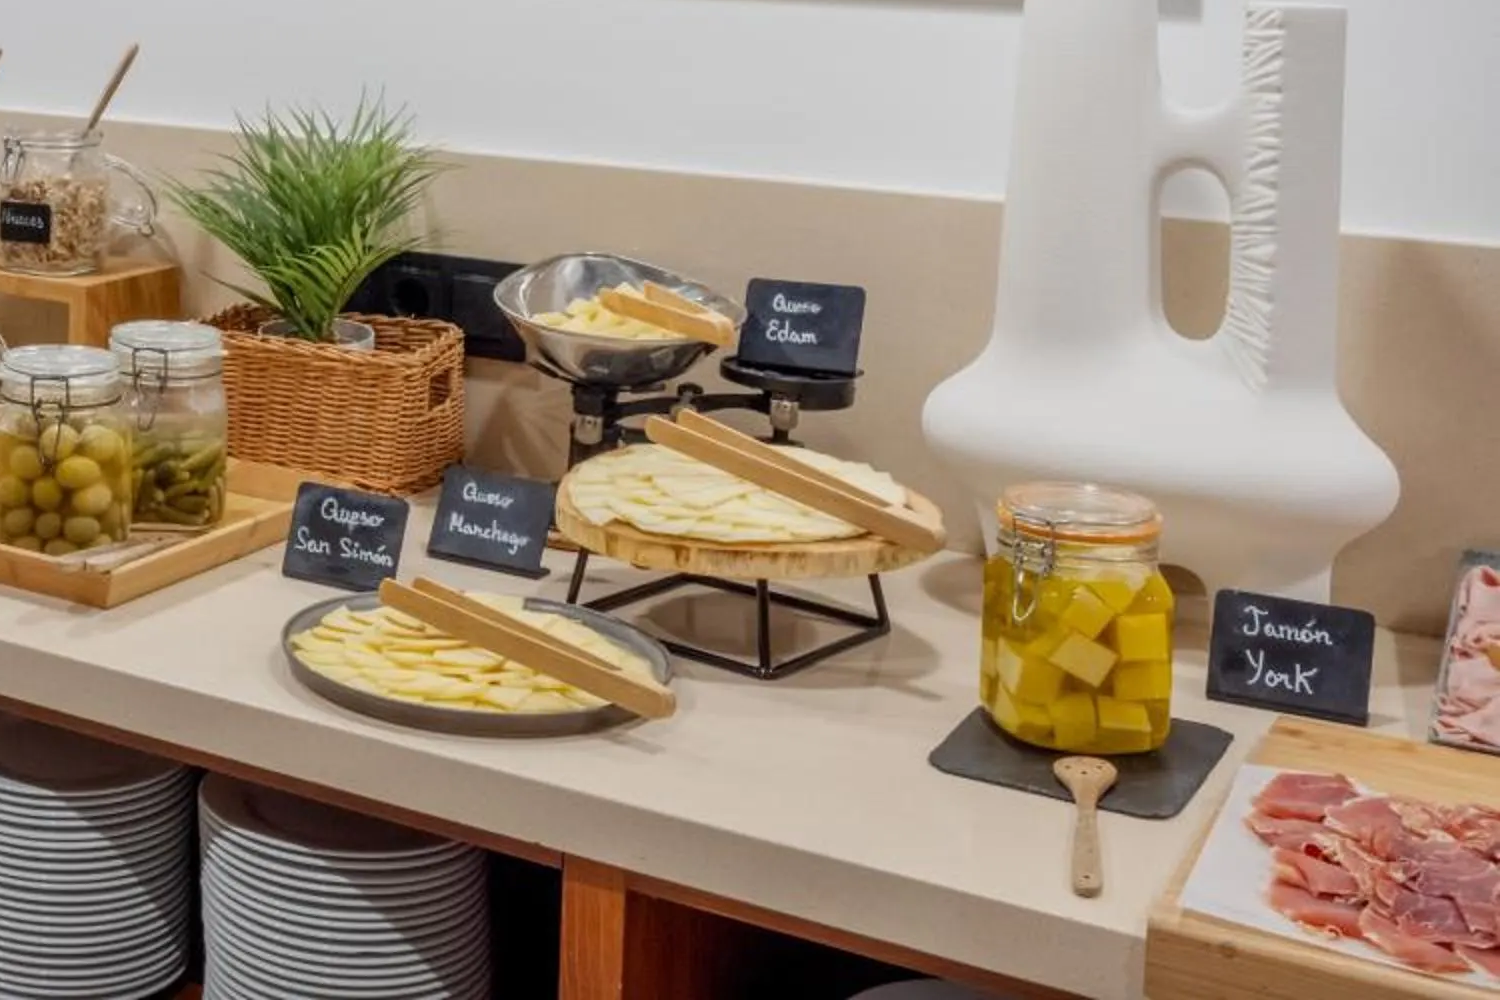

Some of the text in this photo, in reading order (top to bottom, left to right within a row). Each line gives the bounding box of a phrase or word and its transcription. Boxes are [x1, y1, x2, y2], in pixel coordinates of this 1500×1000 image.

[772, 293, 822, 315] Queso
[765, 320, 817, 345] Edam
[462, 482, 514, 508] Queso
[320, 497, 385, 527] Queso
[295, 526, 394, 567] San Simón
[1243, 604, 1333, 645] Jamón
